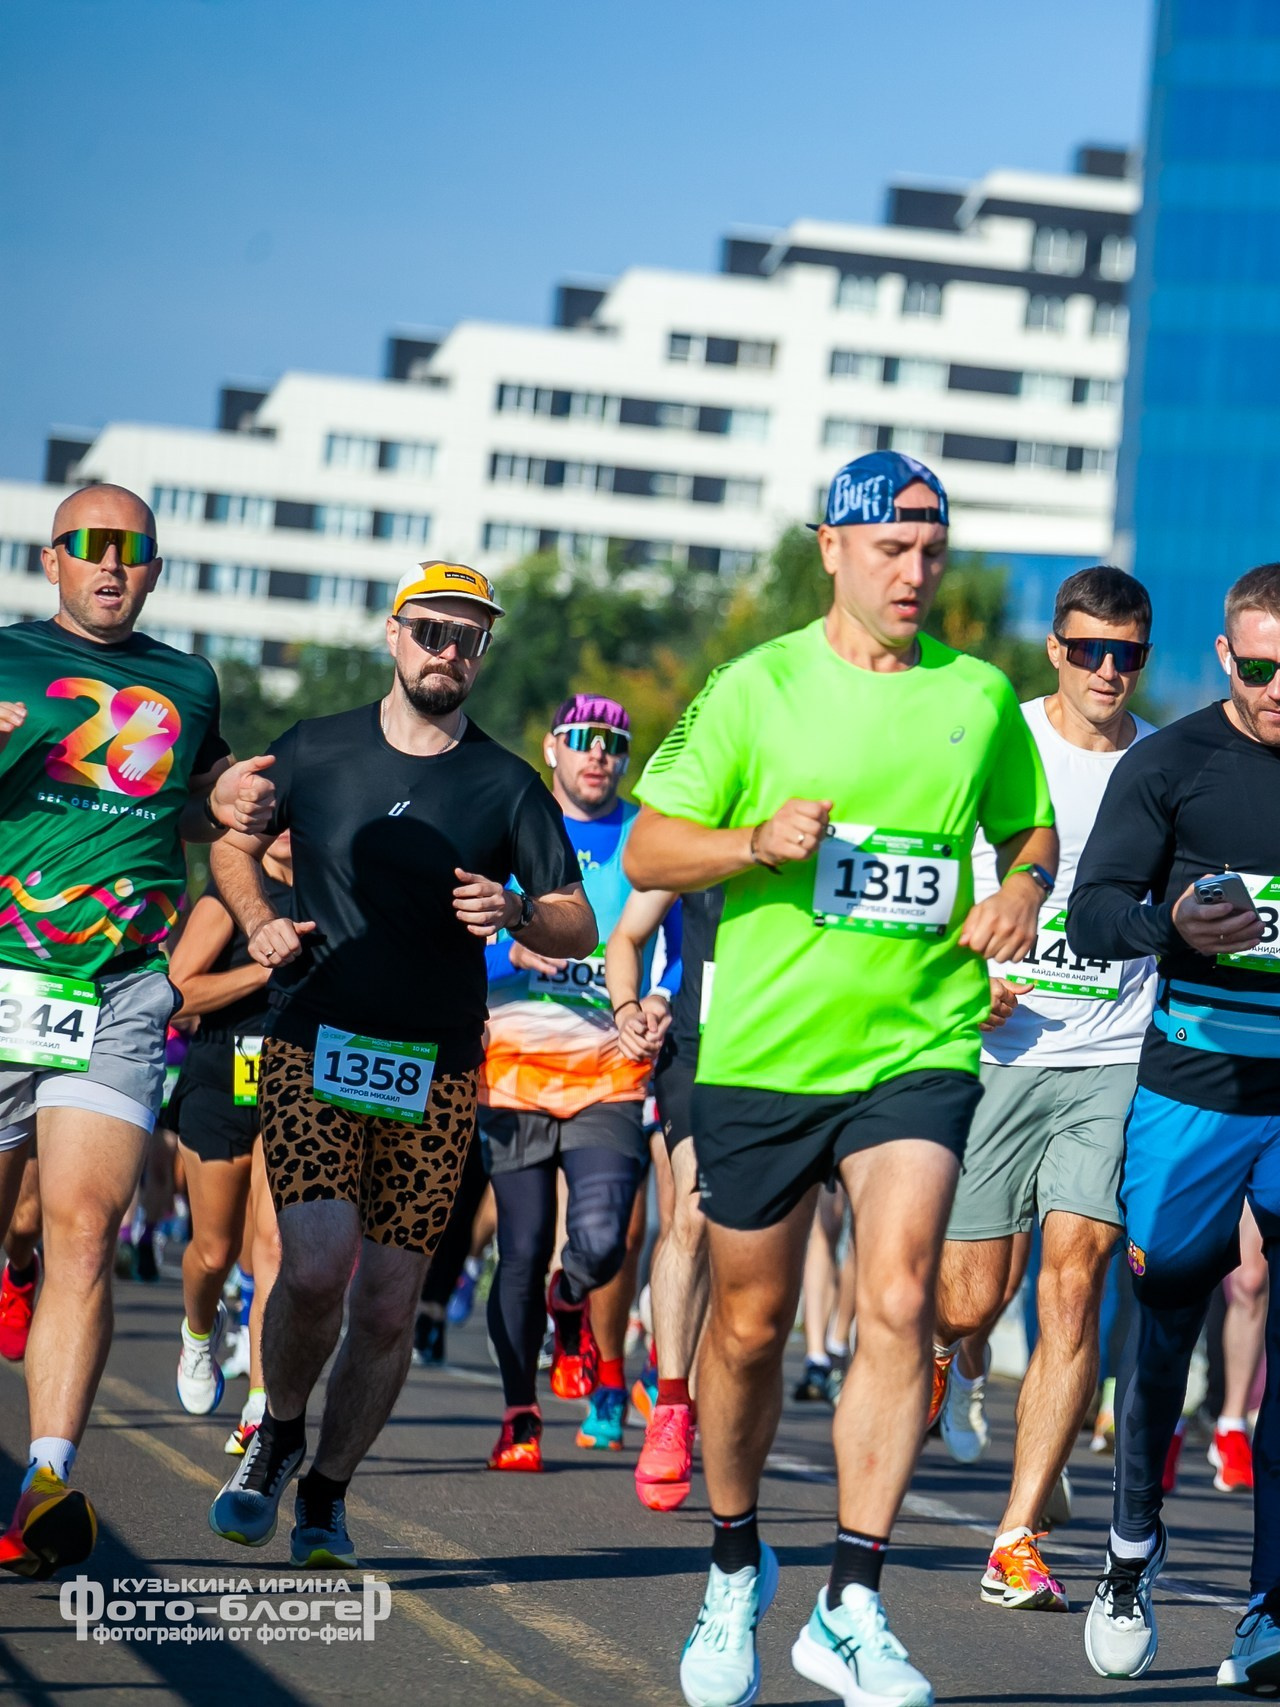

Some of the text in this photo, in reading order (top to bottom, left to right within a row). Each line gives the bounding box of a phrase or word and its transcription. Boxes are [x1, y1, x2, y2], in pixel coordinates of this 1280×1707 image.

[71, 797, 157, 821] ОБЪЕДИЯЕТ
[834, 858, 940, 906] 1313
[1031, 968, 1099, 982] БАЙДАКОВ АНДРЕЙ
[0, 999, 84, 1043] 344
[323, 1050, 422, 1096] 1358
[339, 1086, 400, 1103] ХИТРОВ МИХАИЛ
